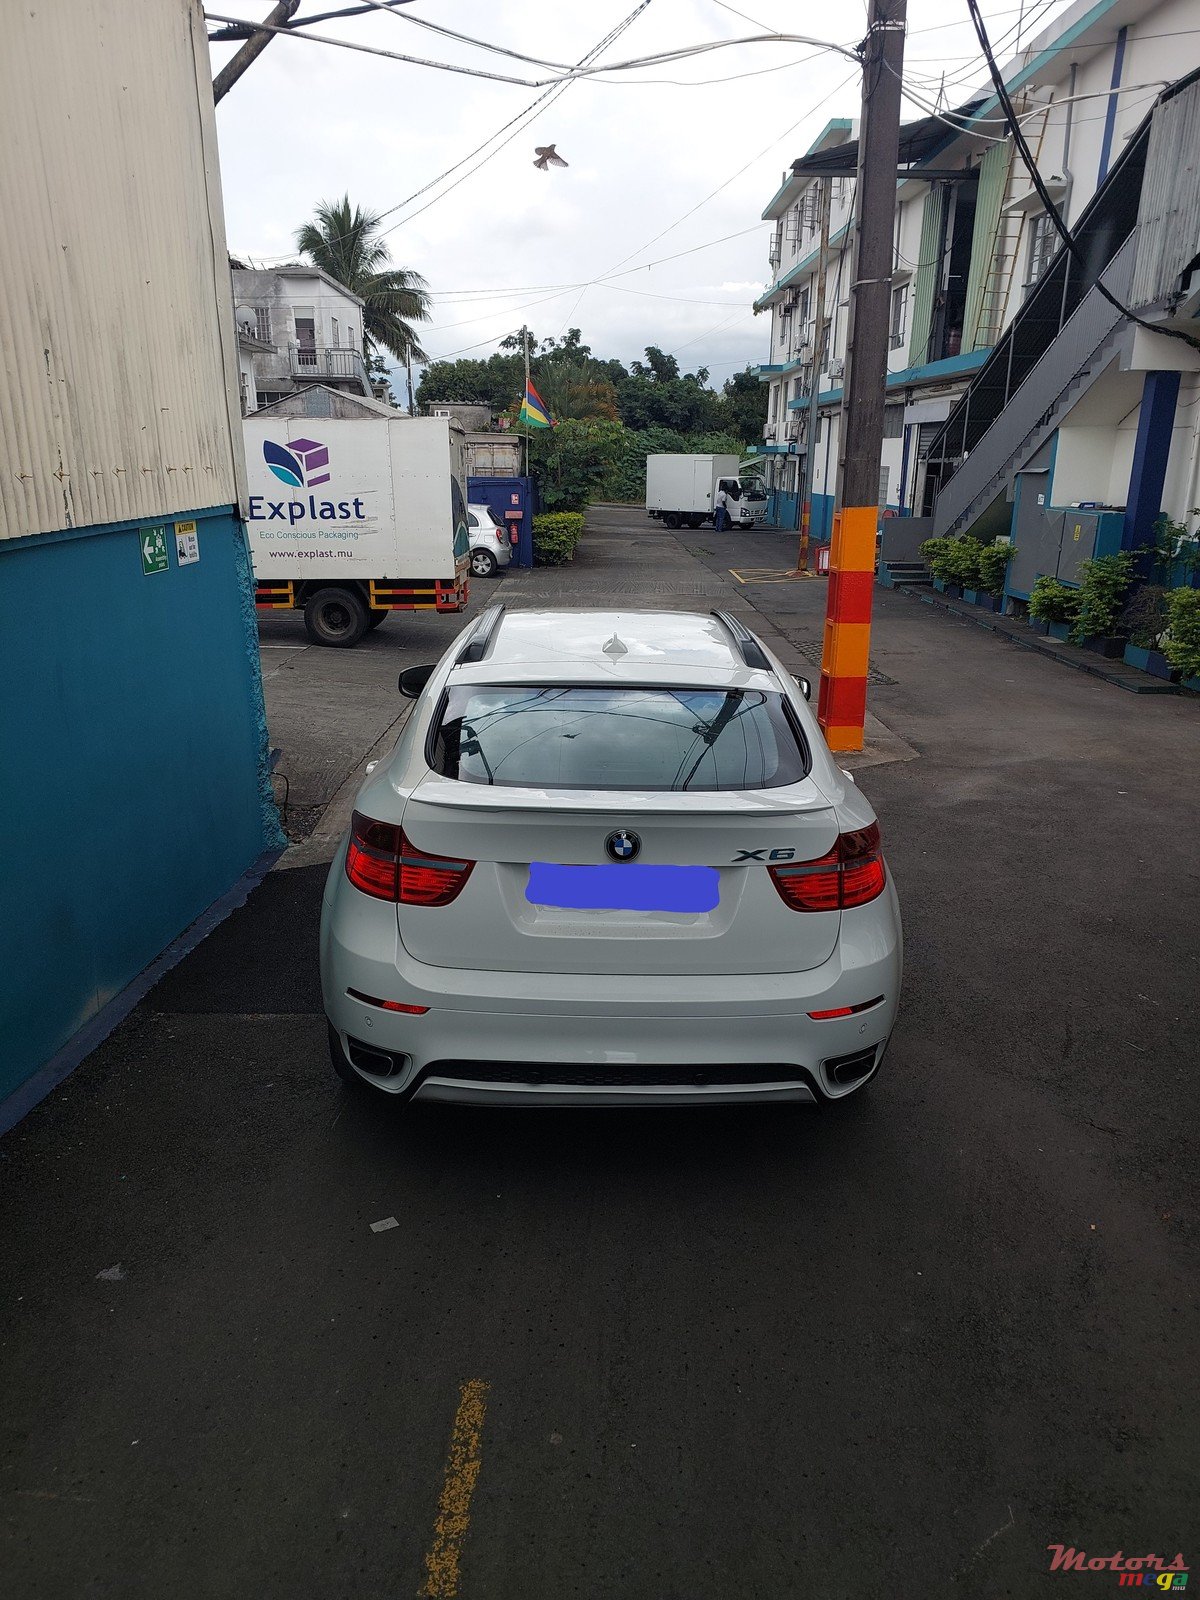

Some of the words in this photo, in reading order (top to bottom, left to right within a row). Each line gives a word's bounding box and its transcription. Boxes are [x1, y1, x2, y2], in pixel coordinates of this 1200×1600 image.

[248, 495, 366, 526] Explast
[260, 531, 275, 540] Eco
[276, 531, 317, 540] Conscious
[318, 531, 359, 541] Packaging
[269, 550, 353, 560] www.explast.mu
[731, 848, 796, 862] X6
